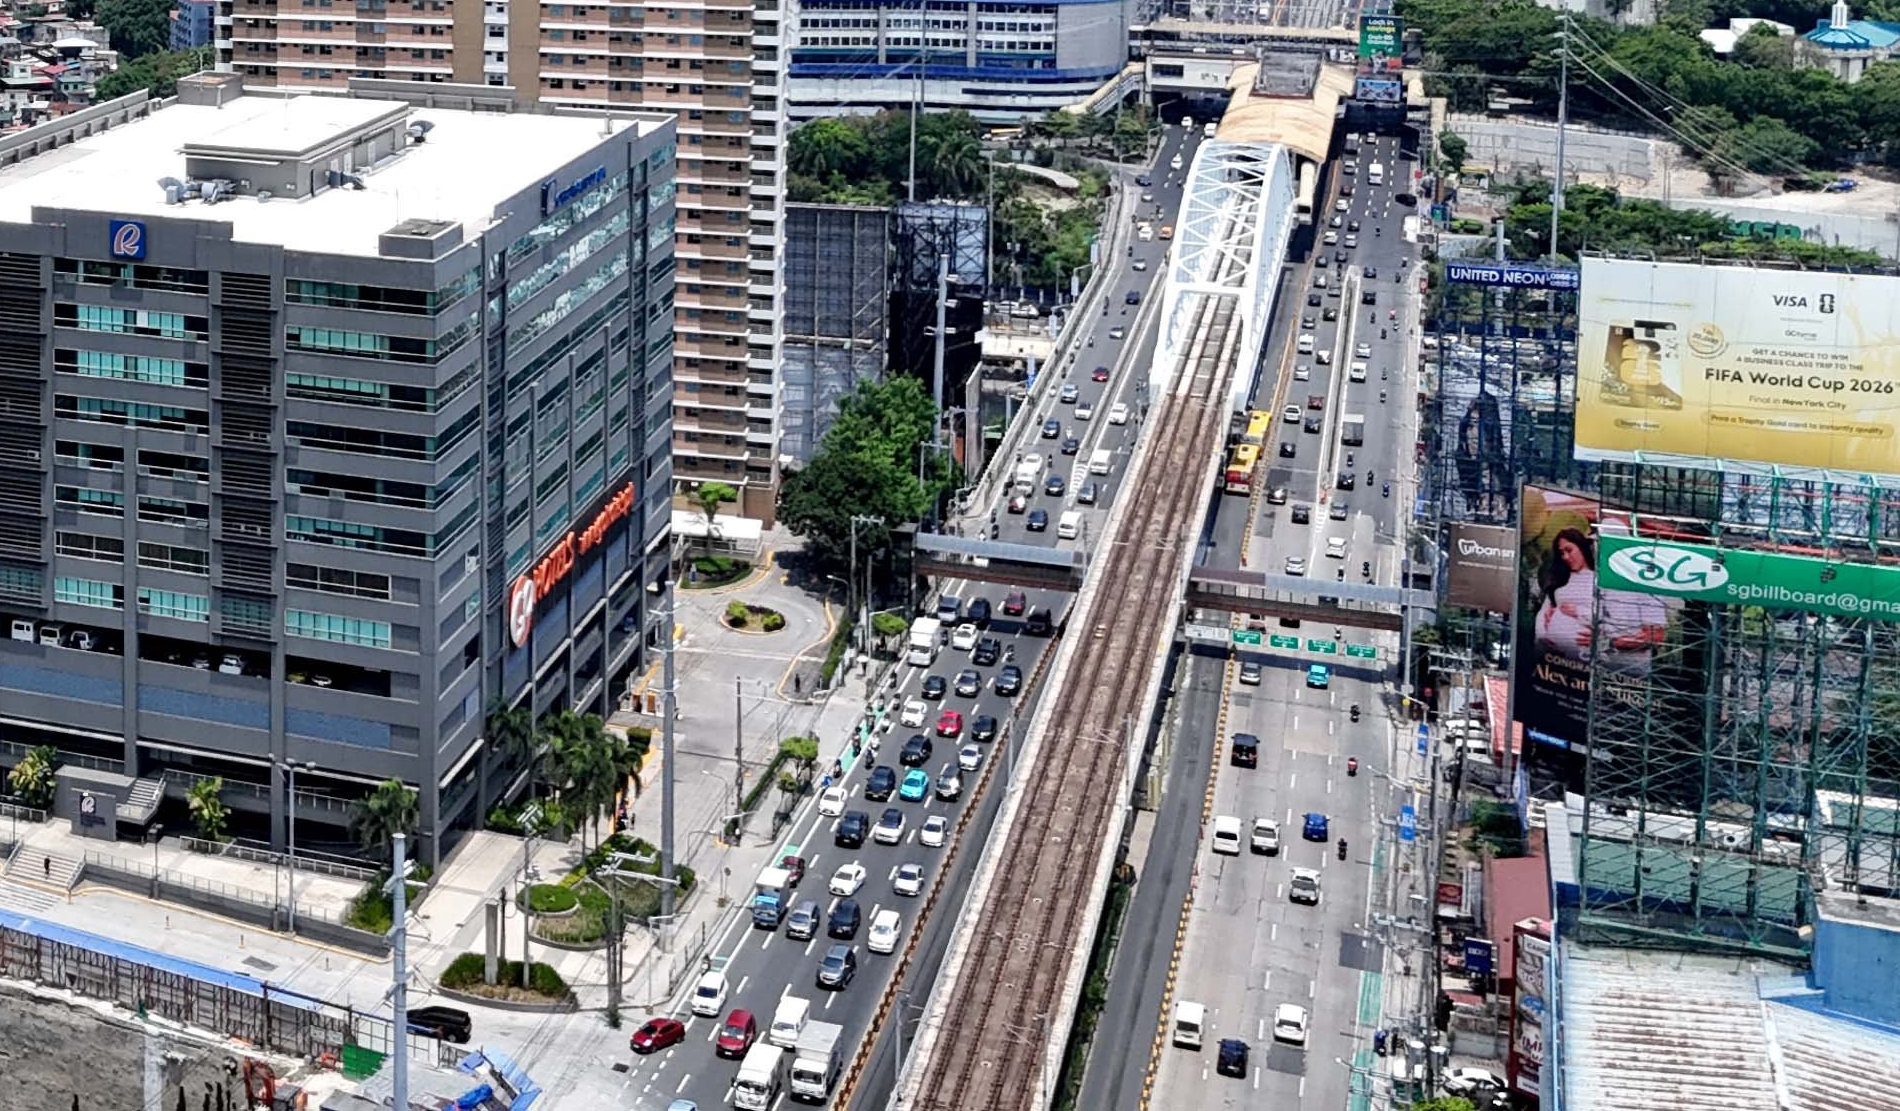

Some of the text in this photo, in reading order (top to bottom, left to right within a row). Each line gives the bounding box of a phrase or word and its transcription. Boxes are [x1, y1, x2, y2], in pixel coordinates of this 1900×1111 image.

[114, 223, 140, 256] R
[1451, 268, 1500, 282] UNITED
[1503, 271, 1545, 285] NEON
[1773, 295, 1807, 307] VISA
[1778, 350, 1814, 359] CHANCE
[1816, 352, 1828, 360] TO
[1705, 368, 1893, 394] FIFA World Cup 2026
[1727, 582, 1900, 613] sgbillboard@gma
